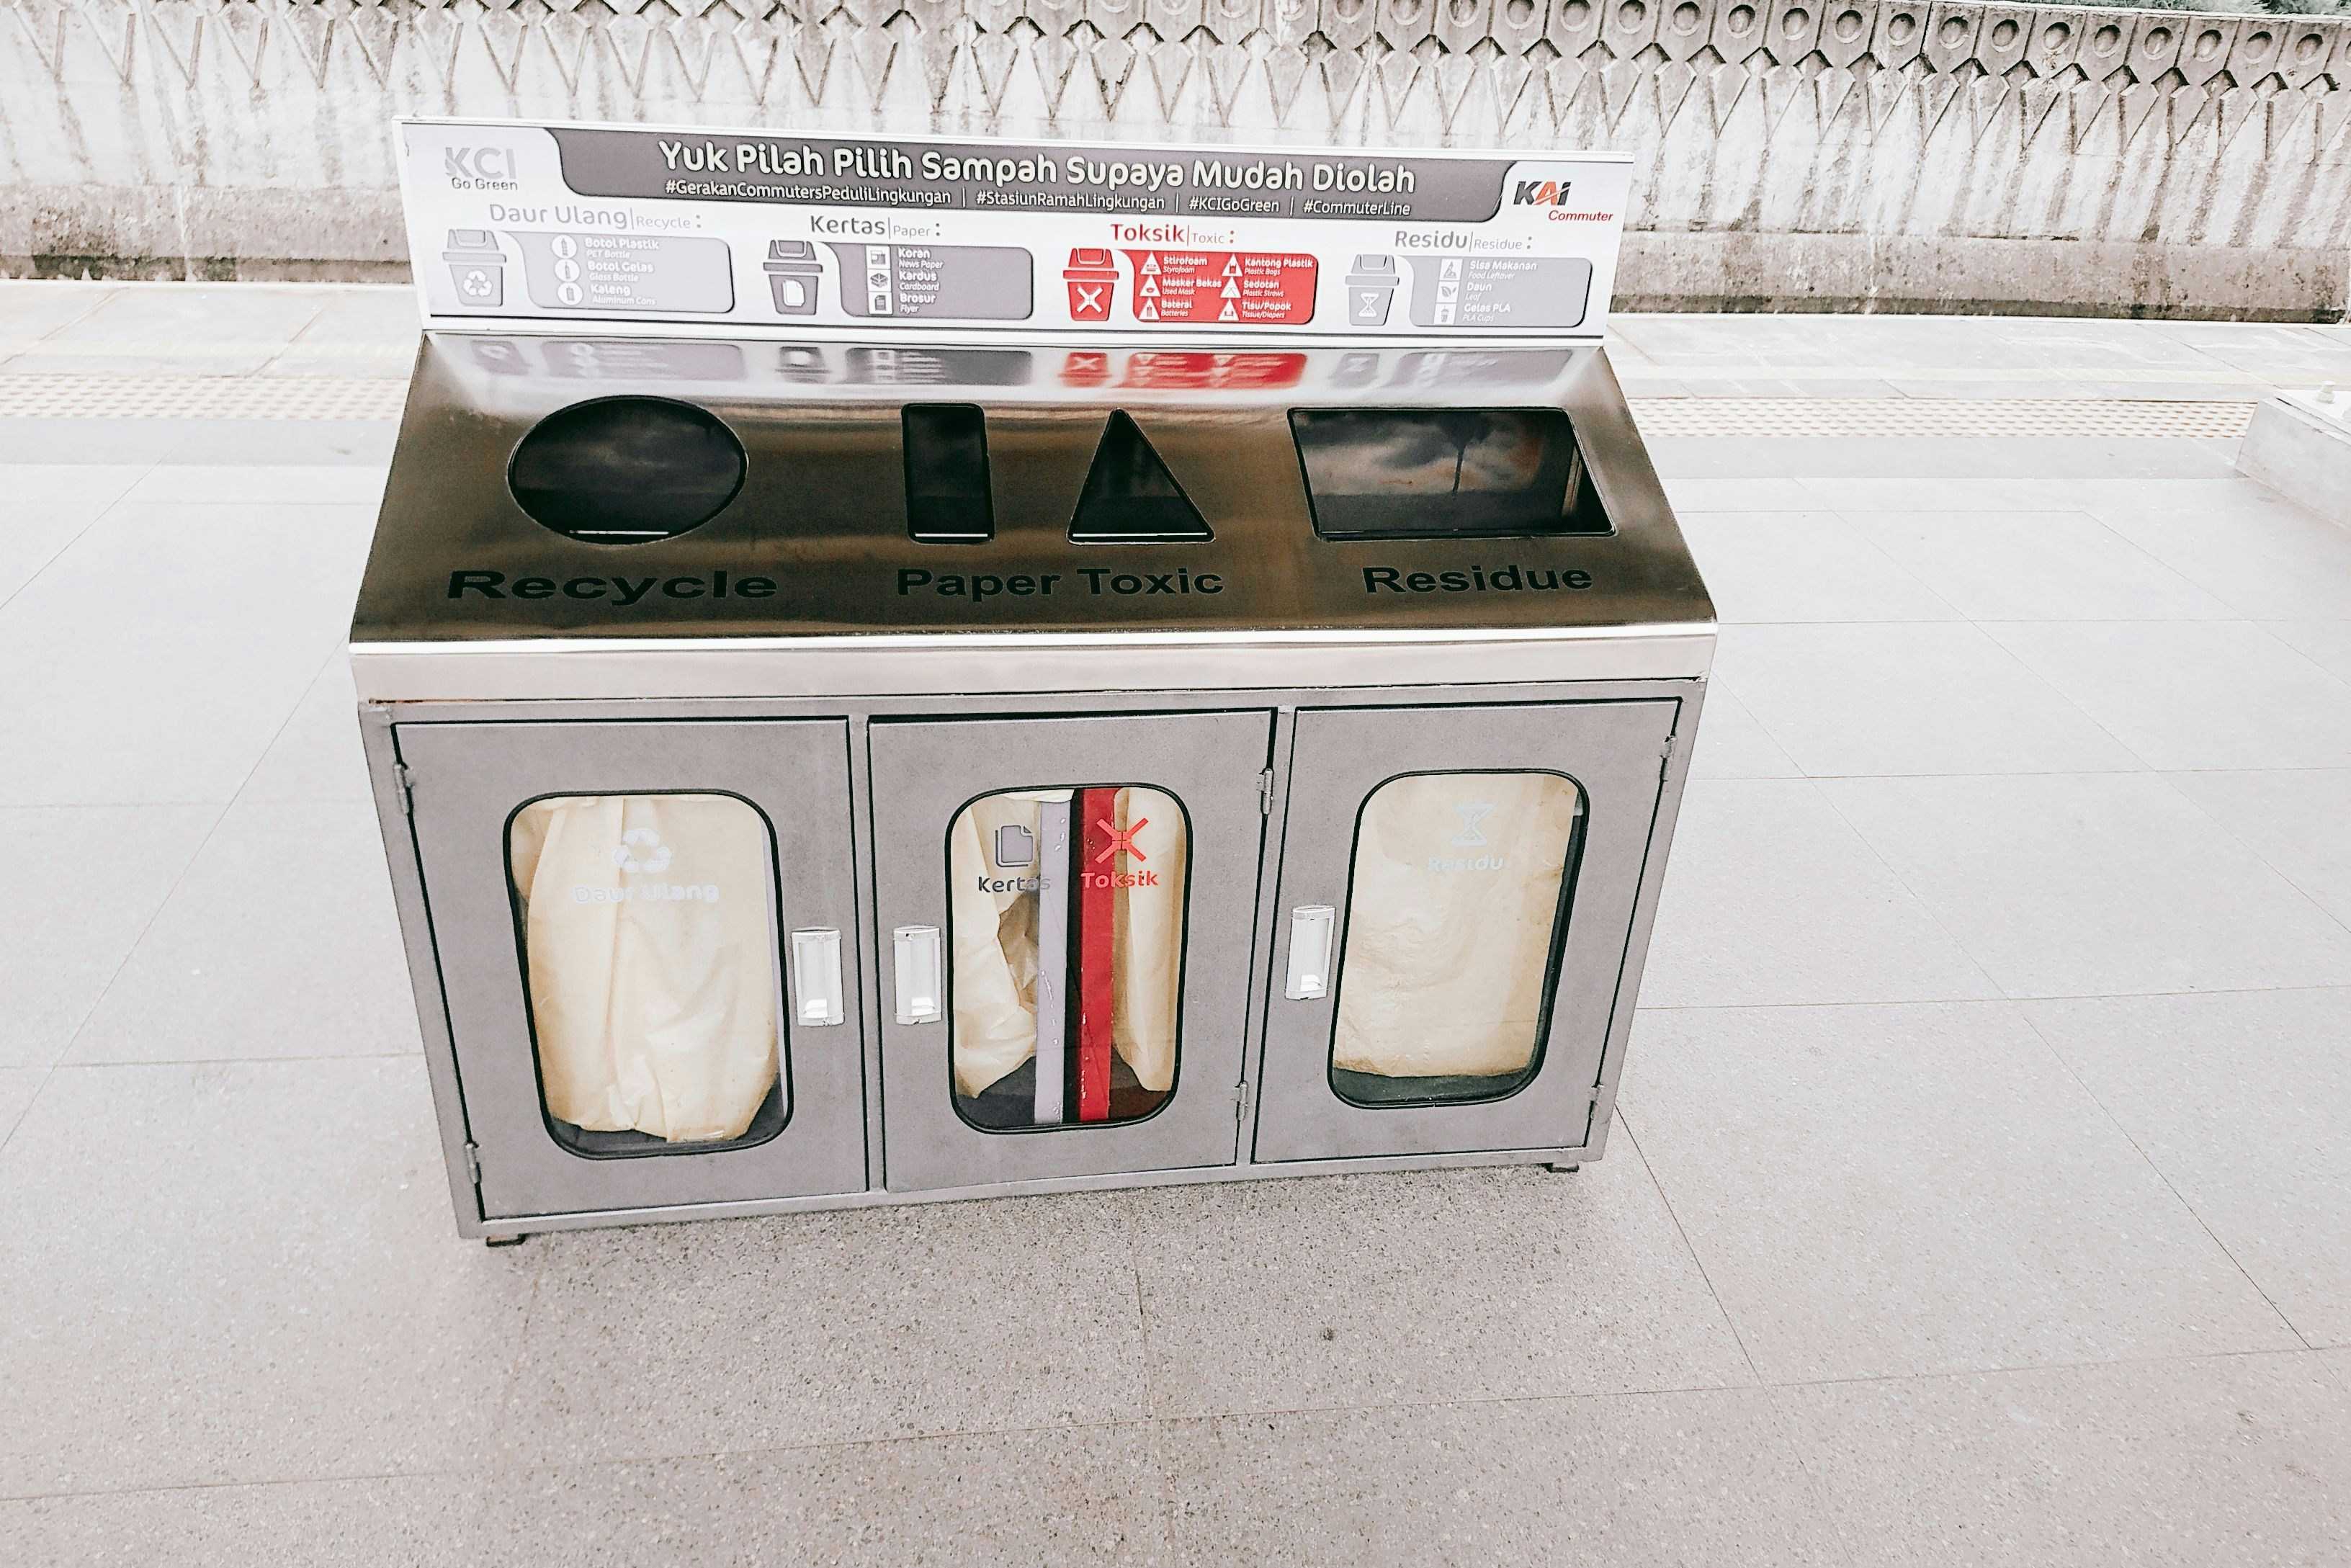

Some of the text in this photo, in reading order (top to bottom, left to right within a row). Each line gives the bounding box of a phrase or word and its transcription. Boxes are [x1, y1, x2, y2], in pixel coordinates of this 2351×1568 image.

[445, 147, 516, 179] KCI
[658, 140, 1415, 193] Yuk Pilah Pilih Sampah Supaya Mudah Diolah
[452, 176, 518, 191] Go Green
[665, 179, 1411, 217] #GerakanCommutersPeduliLingkungan #StasiunRamahLingkungan #KCIGoGreen #CommuterLine
[489, 204, 548, 224] Daur
[555, 205, 628, 230] Ulang
[636, 216, 691, 230] Recycle
[1548, 210, 1614, 223] Commuter
[810, 215, 886, 236] Kertas
[892, 224, 931, 238] Paper
[1110, 223, 1186, 243] Toksik
[1192, 232, 1225, 245] Toxic
[1394, 230, 1468, 248] Residu
[1474, 238, 1523, 251] Residue
[585, 237, 660, 250] Botol Plastik
[586, 249, 603, 258] PET
[897, 247, 931, 259] Koran
[587, 260, 654, 273] Botol Gelas
[898, 259, 944, 270] News Paper
[1245, 259, 1281, 269] Kantong
[1492, 261, 1537, 271] Makanan
[898, 270, 937, 282] Kardus
[1468, 271, 1486, 279] Food
[899, 282, 940, 291] Cardboard
[1162, 278, 1222, 288] Masker Bekas
[1243, 279, 1280, 290] Sedotan
[1466, 282, 1492, 292] Daun
[590, 284, 632, 297] Kaleng
[900, 292, 936, 304] Brosur
[900, 304, 920, 314] Flyer
[1464, 303, 1511, 313] Gelas PLA
[1477, 314, 1495, 323] Cups
[897, 565, 1224, 602] Paper Toxic
[1363, 563, 1593, 594] Residue
[447, 569, 779, 606] Recycle
[1426, 854, 1504, 872] Residu
[977, 876, 1052, 893] Kertas
[1080, 871, 1159, 889] Toksik
[573, 884, 720, 905] Daur Ulang
